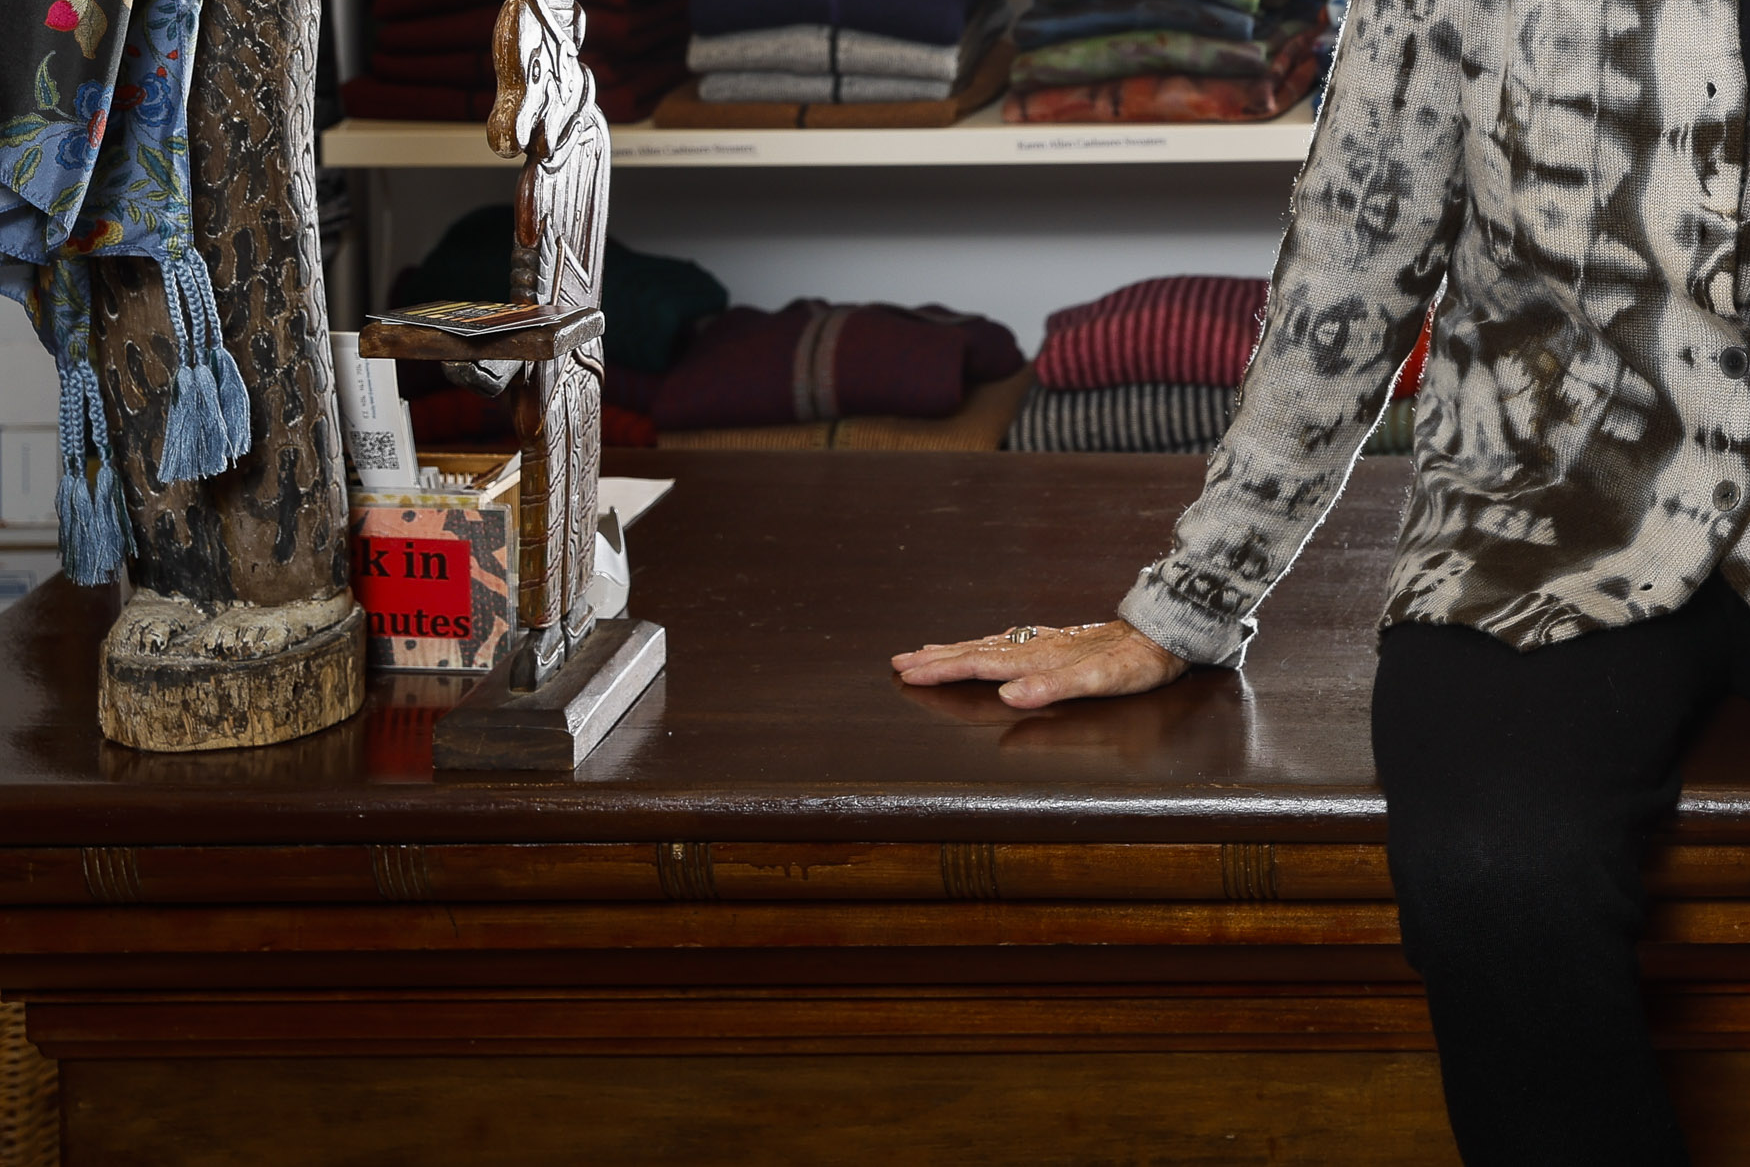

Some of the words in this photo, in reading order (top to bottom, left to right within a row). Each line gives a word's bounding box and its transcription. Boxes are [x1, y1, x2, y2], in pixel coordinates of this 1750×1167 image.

[351, 537, 391, 578] k
[402, 541, 449, 581] in
[366, 609, 470, 638] nutes
